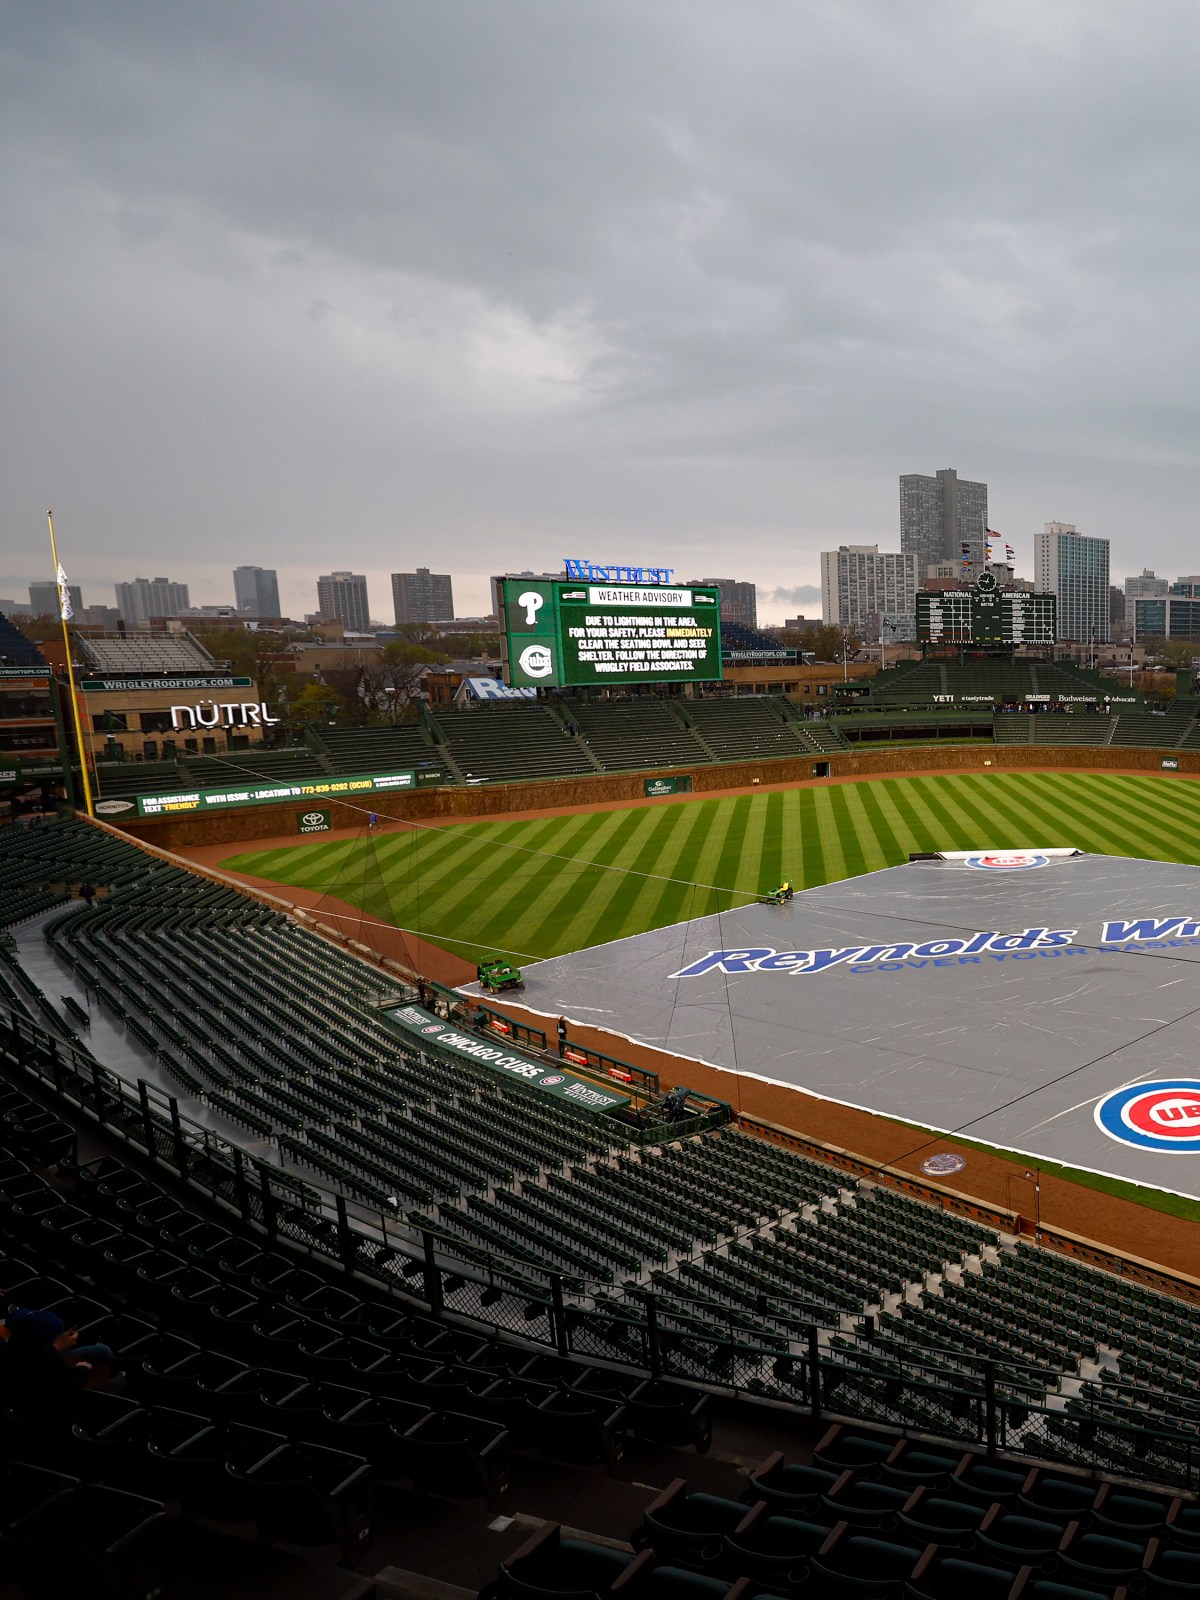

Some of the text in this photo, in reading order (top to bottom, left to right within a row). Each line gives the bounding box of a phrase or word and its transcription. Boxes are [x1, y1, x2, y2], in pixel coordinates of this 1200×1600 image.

[563, 559, 674, 583] WINTRUST
[598, 591, 683, 603] WEATHER ADVISORY
[585, 616, 697, 627] DUE TO LIGHTNING IN THE AREA,
[569, 628, 712, 639] FOR YOUR SAFETY, PLEASE IMMEDIATELY
[578, 639, 706, 650] CLEAR THE SEATING BOWL AND SEEK
[578, 649, 707, 662] SHELTER. FOLLOW THE DIRECTION OF
[731, 650, 787, 658] WRIGLEYROOFTOPS.COM
[594, 661, 694, 673] WRIGLEY FIELD ASSOCIATES.
[103, 678, 233, 690] WRIGLEYROOFTOPS.COM
[143, 794, 200, 806] FOR ASSISTANCE
[205, 794, 226, 804] WITH
[227, 792, 250, 802] ISSUE
[255, 787, 291, 799] LOCATION
[291, 786, 301, 795] TO
[143, 801, 200, 813] TEXT "FRIENDLY"
[300, 824, 328, 833] TOYOTA
[667, 927, 1078, 980] Reynolds
[849, 954, 982, 974] COVER
[990, 947, 1090, 962] YOUR
[401, 1006, 431, 1025] WINTRUST
[437, 1033, 504, 1060] CHICAGO
[568, 1082, 617, 1105] WINTRUST
